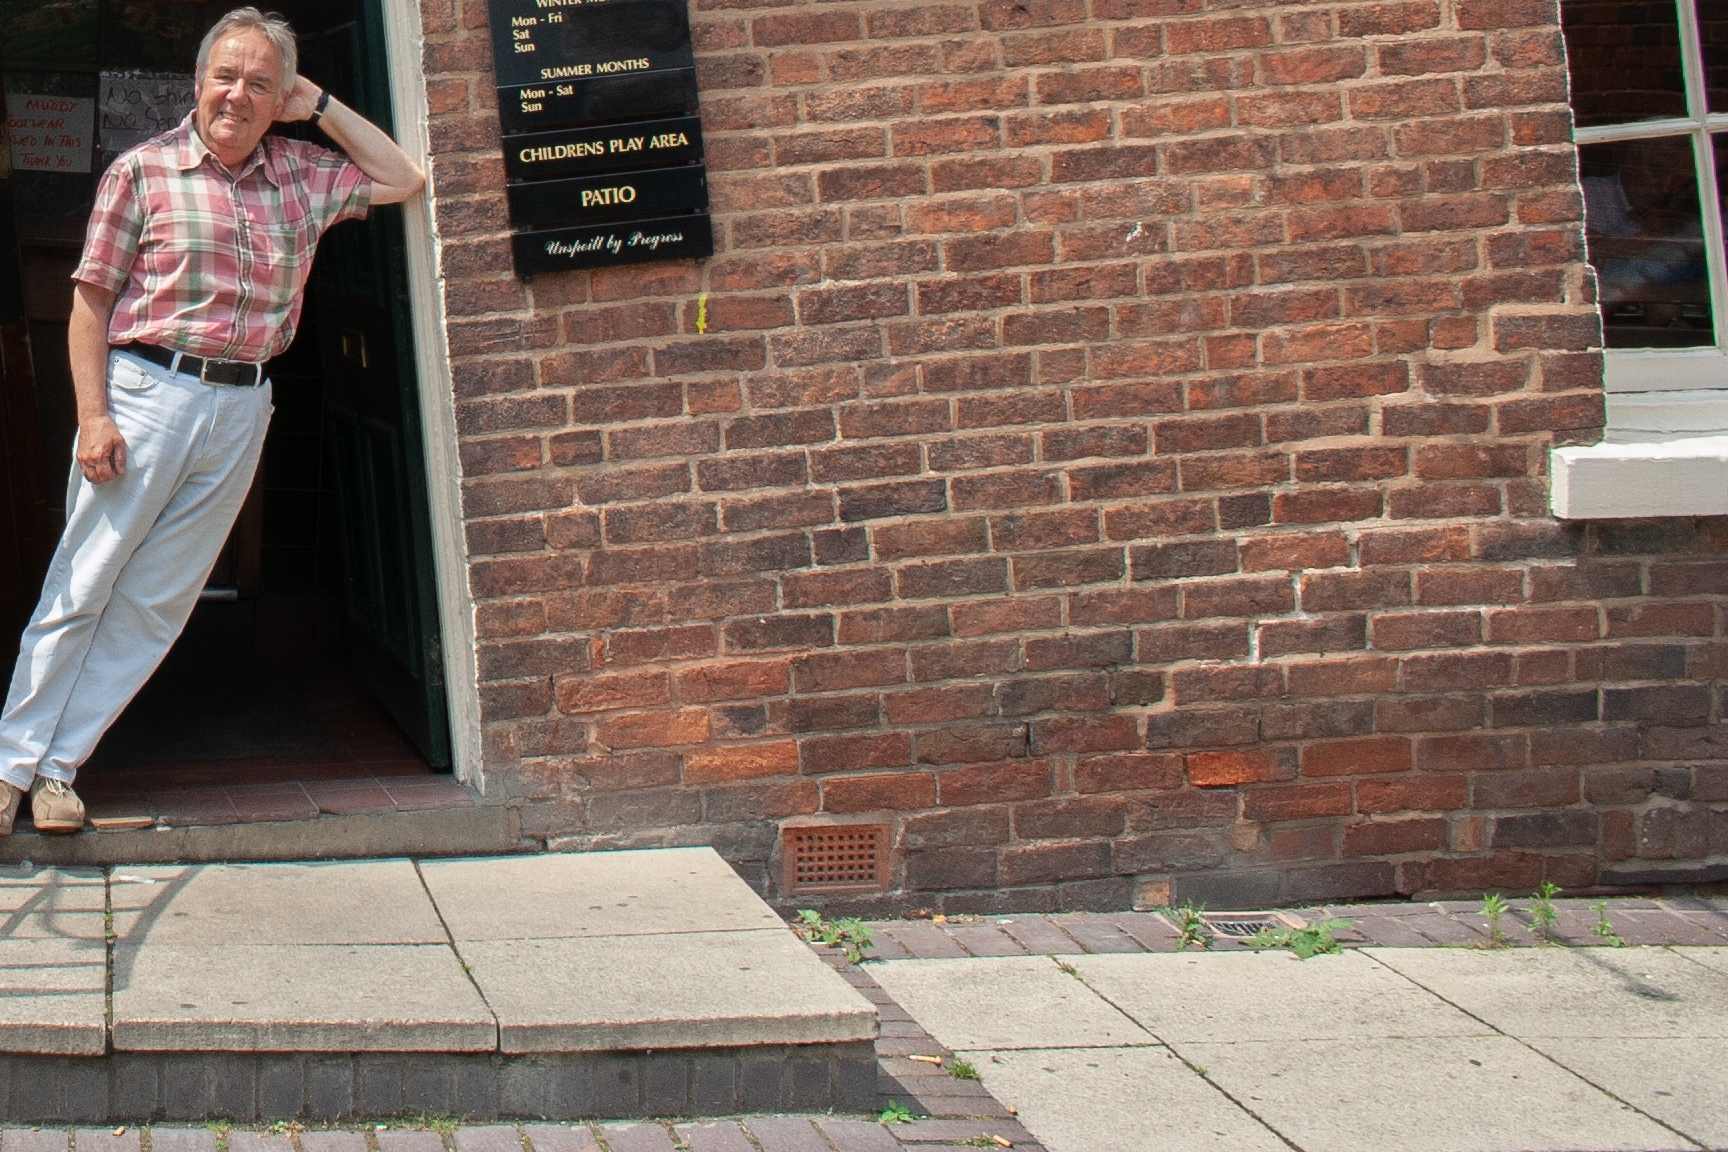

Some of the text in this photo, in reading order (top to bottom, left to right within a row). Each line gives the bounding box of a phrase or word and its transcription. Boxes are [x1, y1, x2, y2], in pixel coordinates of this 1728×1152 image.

[511, 15, 538, 27] Mon
[547, 11, 564, 24] Fri
[512, 29, 531, 41] Sat
[514, 41, 536, 53] Sun
[540, 57, 651, 80] SUMMER MONTHS
[519, 89, 546, 100] Mon
[556, 85, 574, 96] Sat
[24, 99, 77, 112] MUDDY
[521, 101, 543, 113] Sun
[519, 132, 689, 163] CHILDRENS PLAY AREA
[581, 186, 636, 207] PATIO
[544, 231, 684, 258] Unspoilt by Progress
